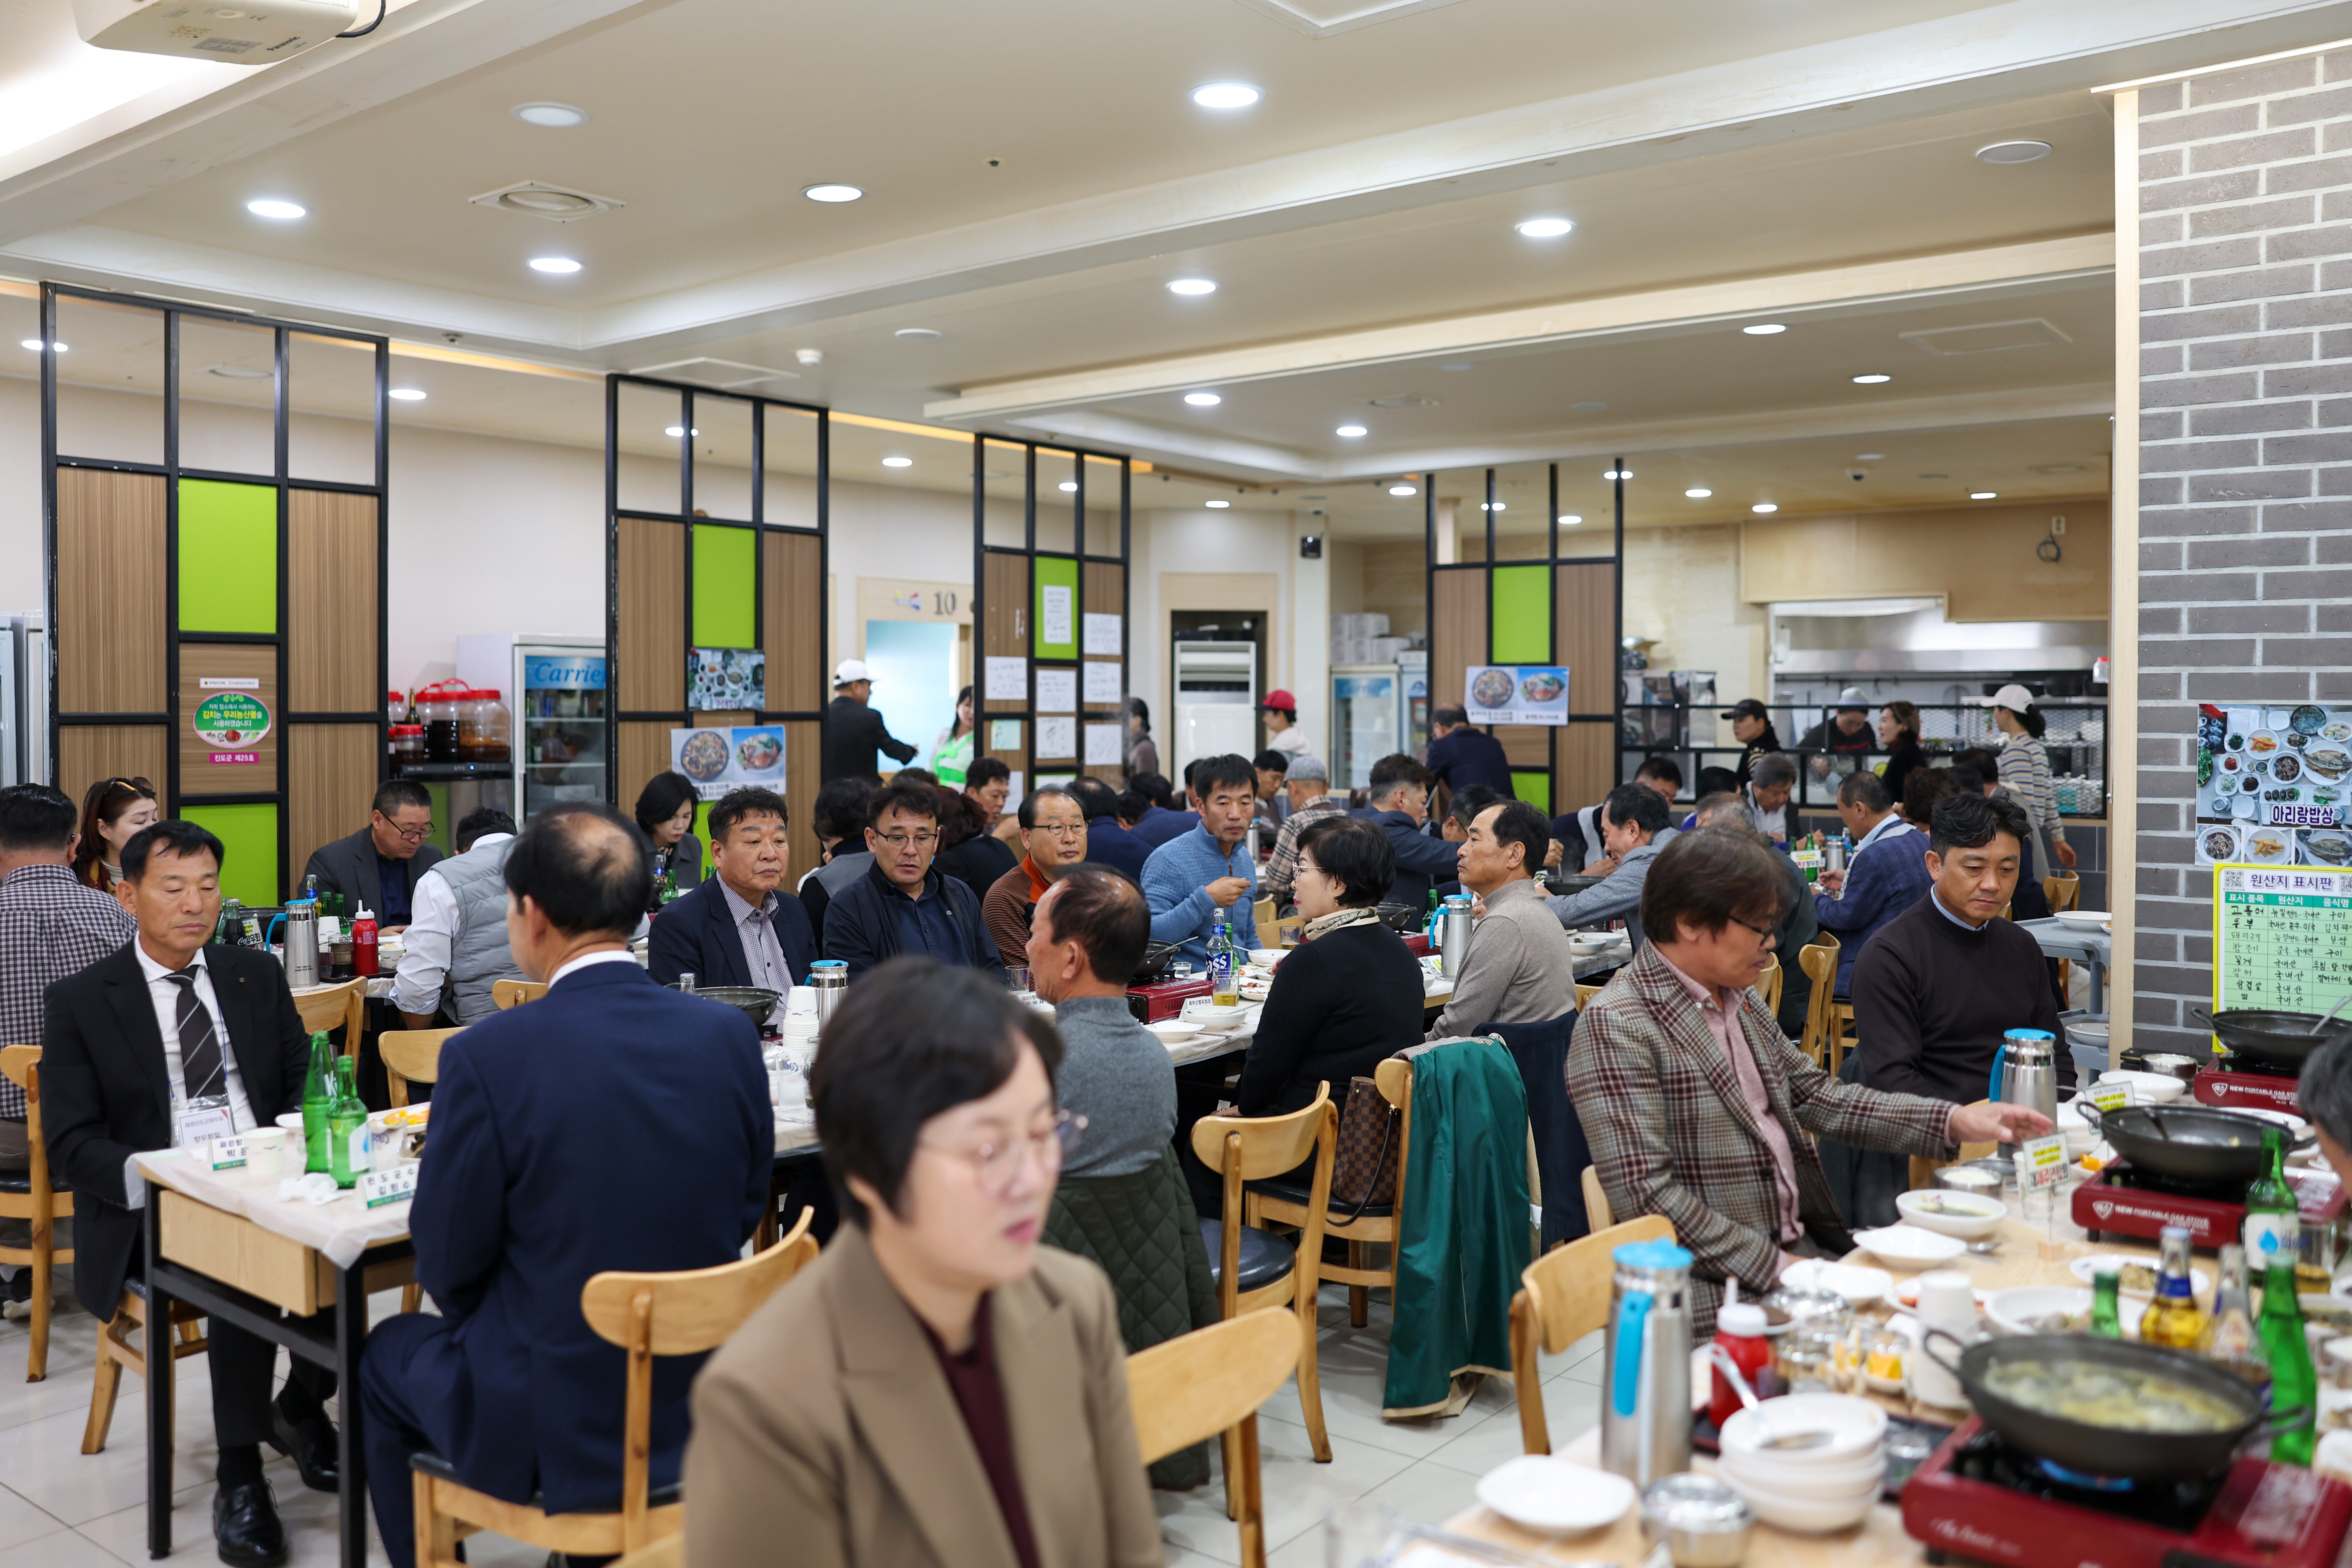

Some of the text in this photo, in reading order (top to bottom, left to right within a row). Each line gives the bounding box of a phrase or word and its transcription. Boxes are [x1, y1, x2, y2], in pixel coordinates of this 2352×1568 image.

[934, 591, 956, 615] 10
[203, 710, 221, 719] 김치는
[2273, 805, 2334, 824] 아리랑밥상
[2250, 874, 2333, 891] 원산지 표시판
[2229, 894, 2265, 903] 표시 품목
[2278, 896, 2303, 905] 원산지
[2323, 898, 2349, 907] 음식명
[1206, 955, 1227, 974] ass
[2273, 959, 2297, 968] 국내산
[2274, 970, 2304, 981] 국내산
[2275, 983, 2303, 994] 국내산
[2276, 995, 2303, 1005] 국내산
[2245, 1087, 2272, 1095] PORTABLE
[2115, 1204, 2133, 1214] NEW
